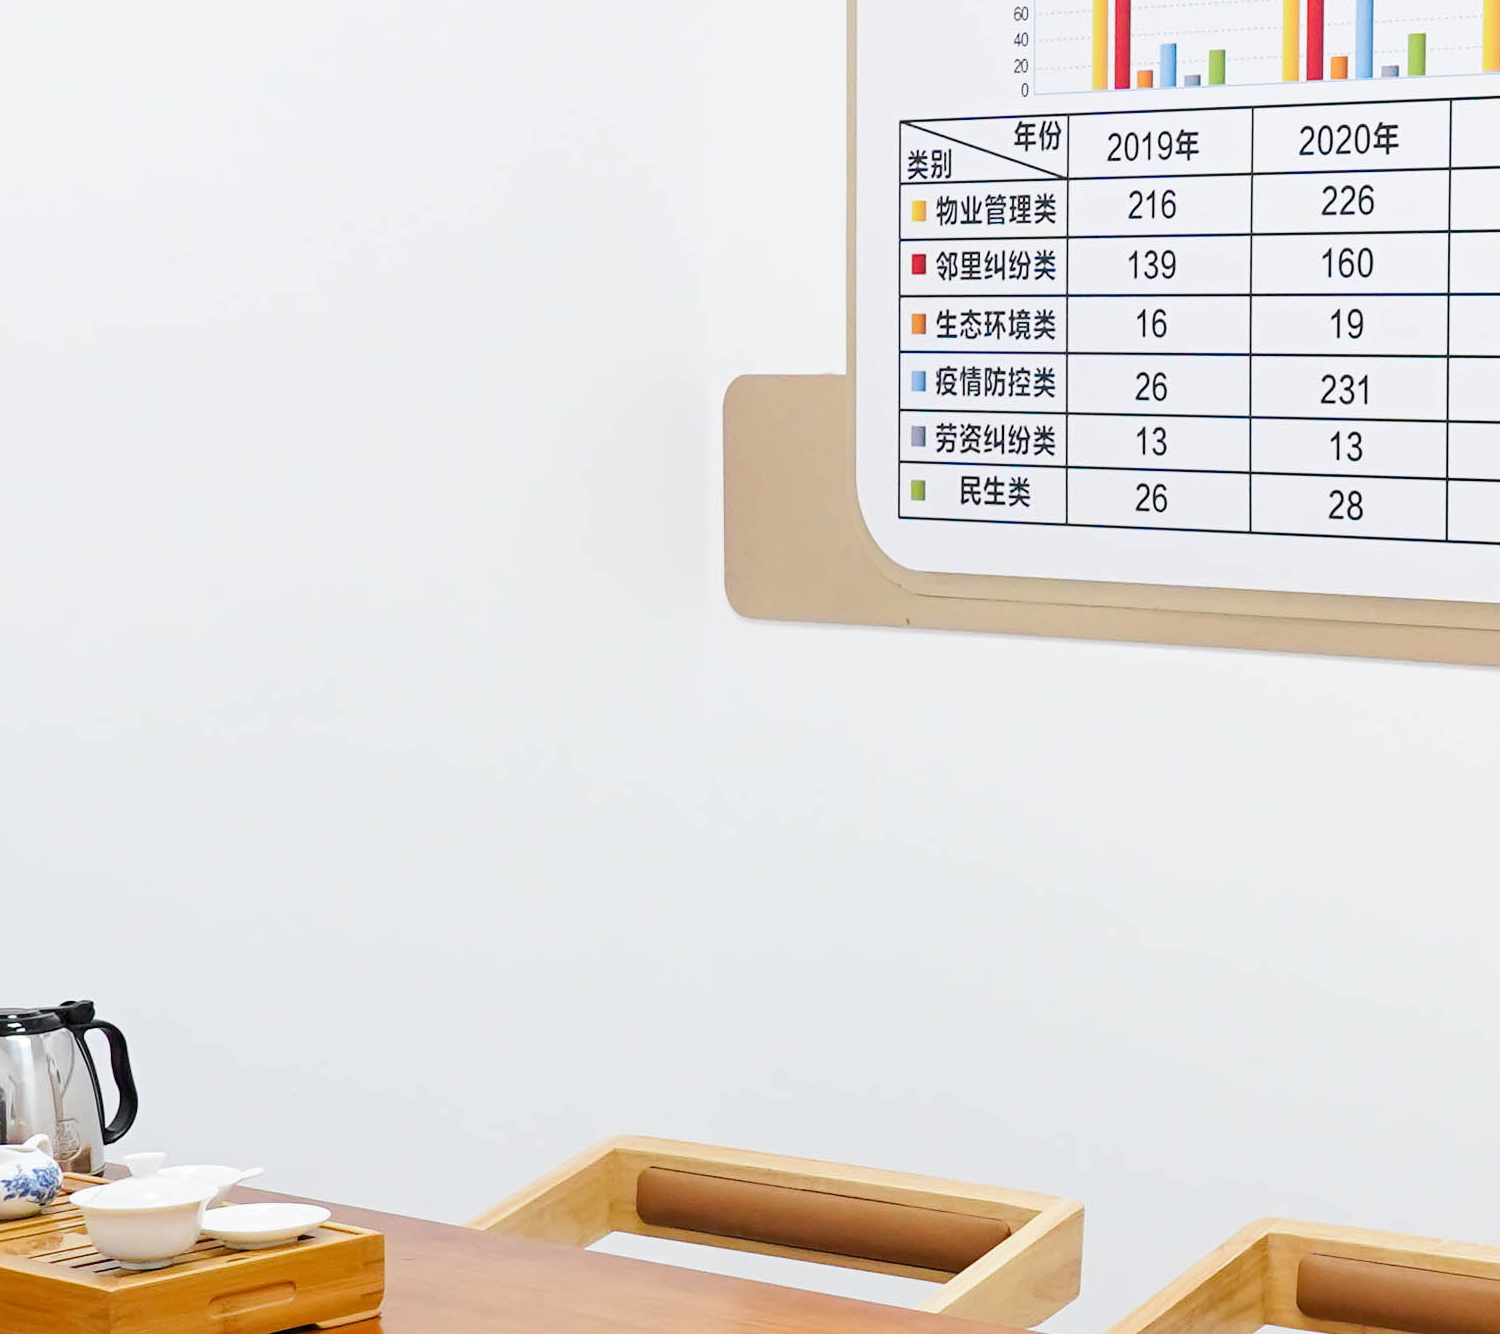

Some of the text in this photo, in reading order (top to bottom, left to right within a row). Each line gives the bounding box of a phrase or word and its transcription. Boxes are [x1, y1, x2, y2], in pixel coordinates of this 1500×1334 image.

[1013, 5, 1029, 21] 60
[1013, 31, 1029, 47] 40
[1013, 58, 1029, 73] 20
[1020, 82, 1030, 97] 0
[1014, 120, 1062, 152] 年份
[1107, 129, 1200, 162] 2019年
[1299, 121, 1399, 156] 2020年
[908, 148, 952, 180] 类别
[936, 193, 1056, 226] 物业管理类
[1128, 189, 1177, 220] 216
[1321, 184, 1375, 216] 226
[936, 249, 1056, 281] 邻里纠纷类
[1128, 249, 1176, 280] 139
[1322, 247, 1374, 279] 160
[936, 309, 1056, 339] 生态环境类
[1137, 308, 1167, 338] 16
[1331, 308, 1364, 340] 19
[936, 366, 1056, 398] 疫情防控类
[1135, 371, 1168, 402] 26
[1320, 374, 1368, 405] 231
[936, 423, 1056, 456] 劳资纠纷类
[1136, 426, 1167, 456] 13
[1330, 430, 1363, 462] 13
[960, 475, 1031, 507] 民生类
[1135, 483, 1168, 513] 26
[1328, 489, 1364, 521] 28
